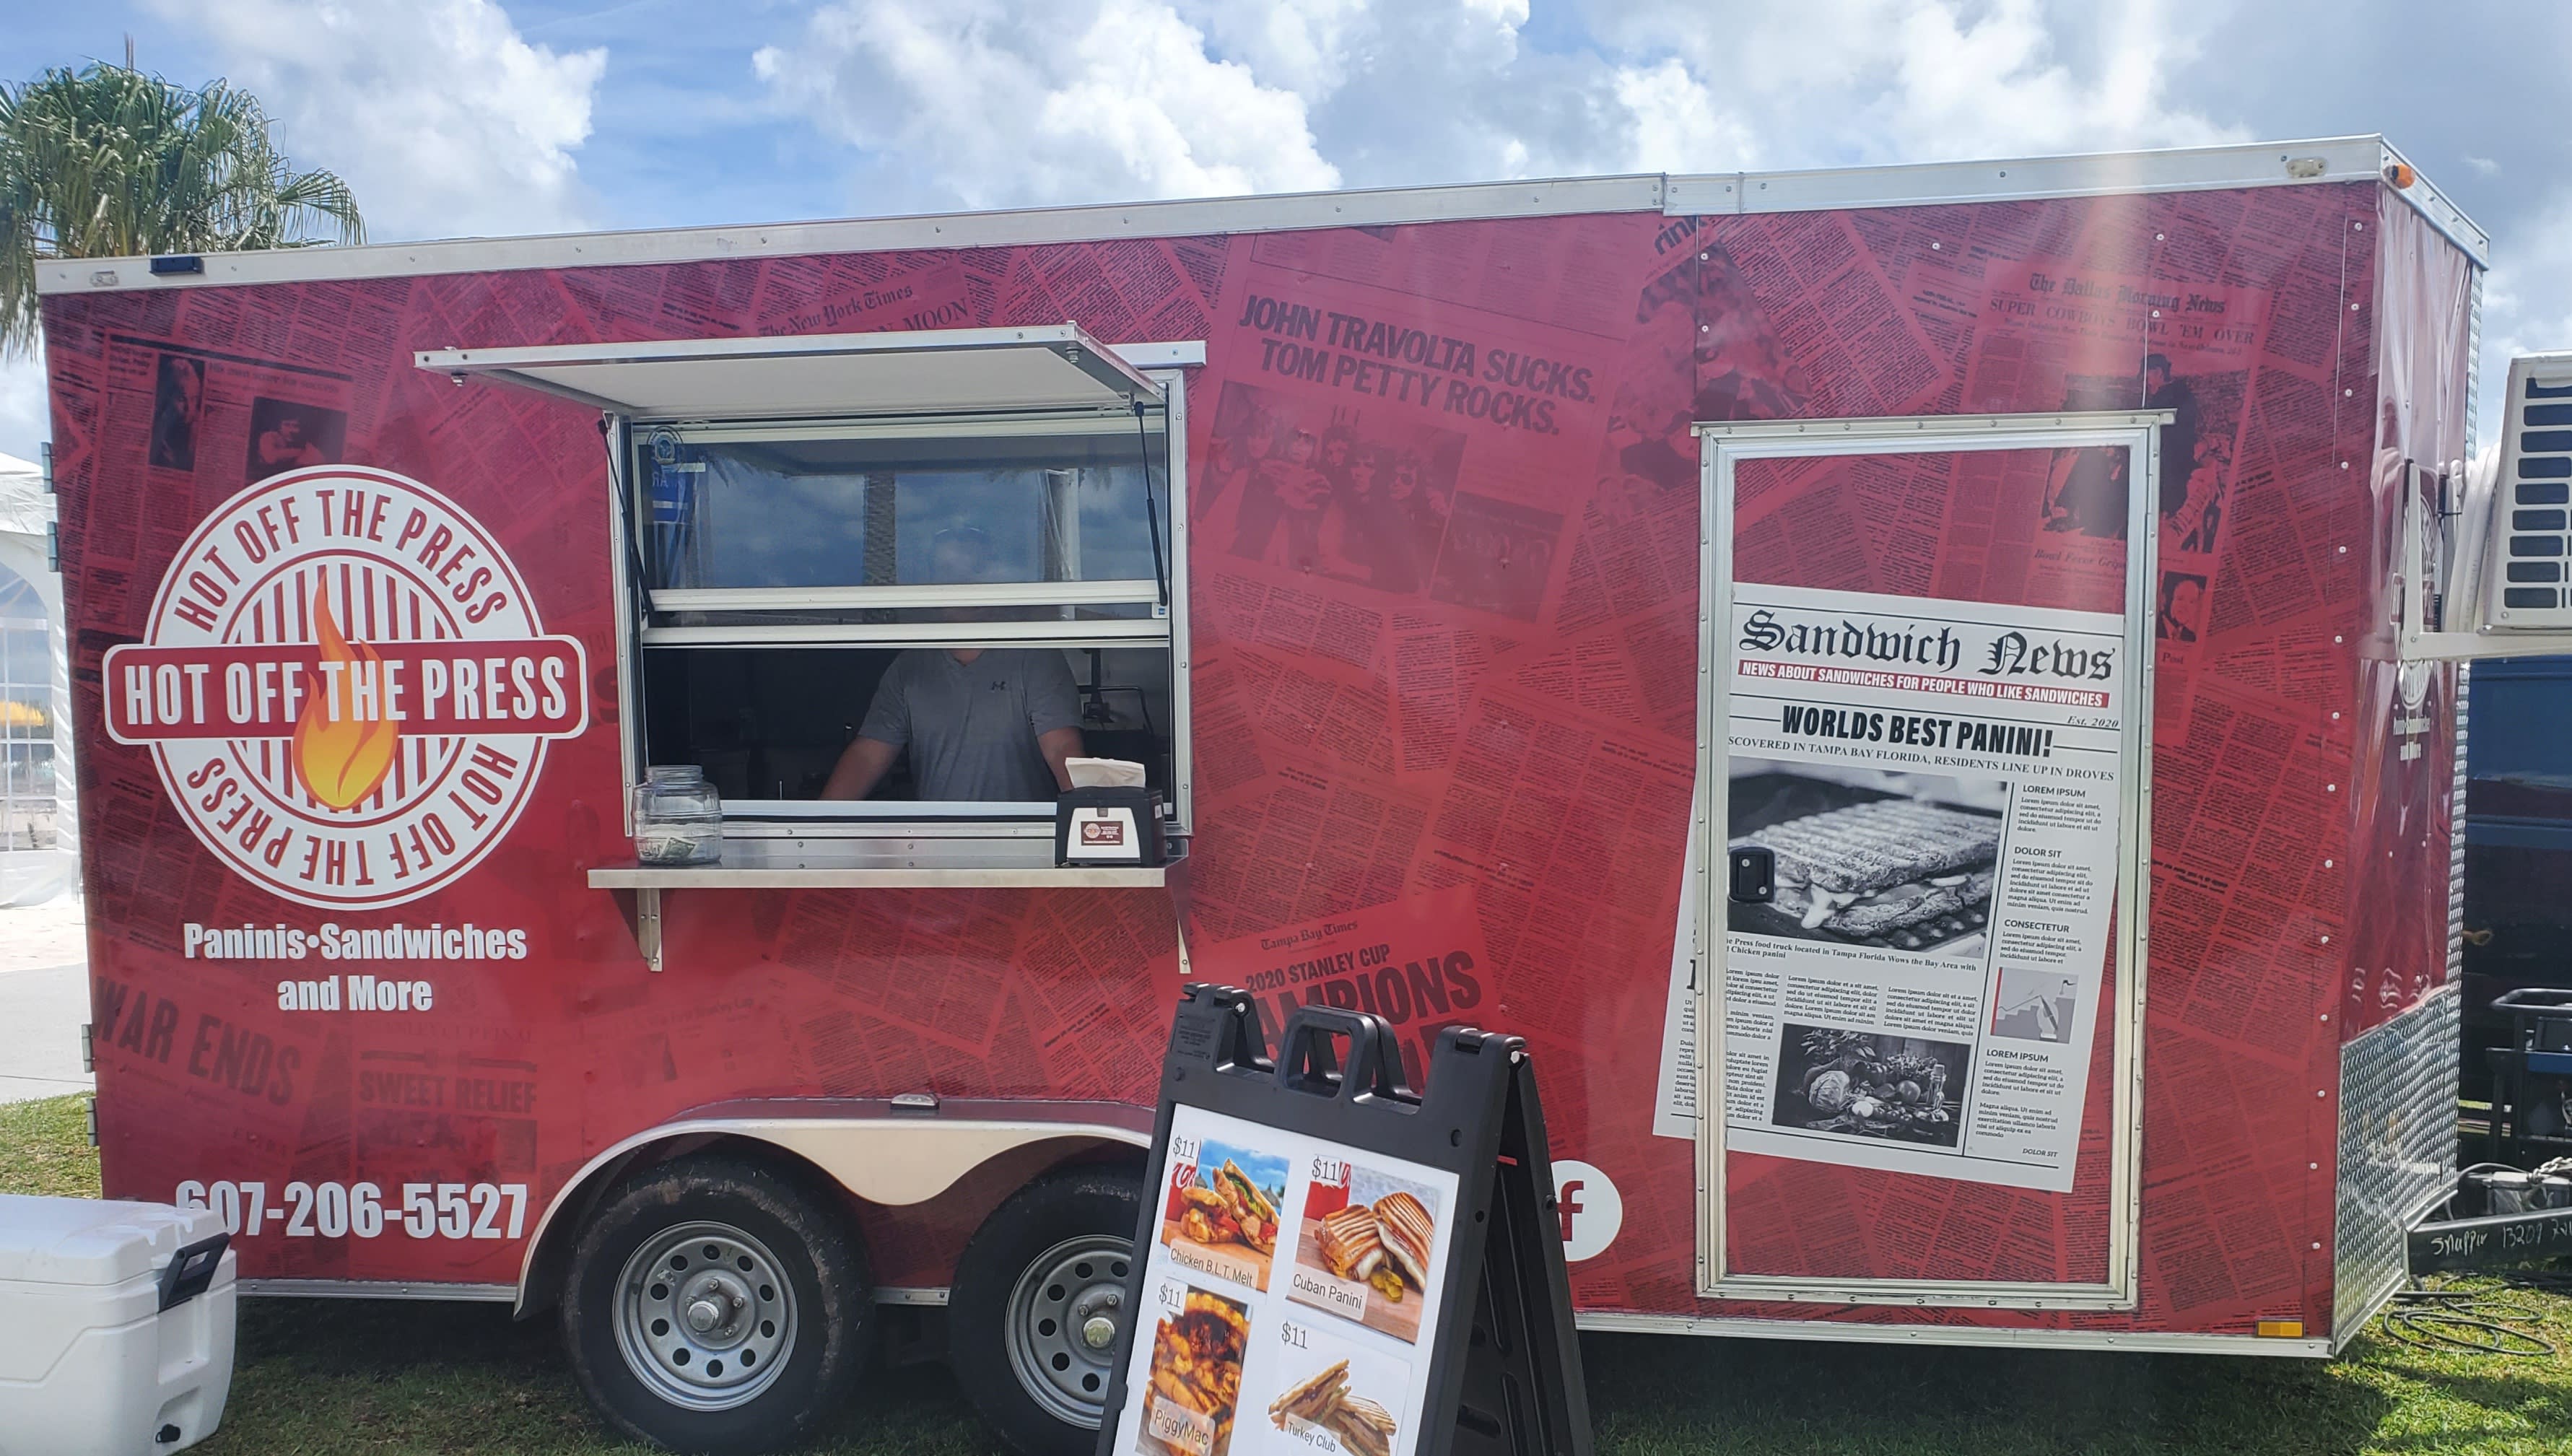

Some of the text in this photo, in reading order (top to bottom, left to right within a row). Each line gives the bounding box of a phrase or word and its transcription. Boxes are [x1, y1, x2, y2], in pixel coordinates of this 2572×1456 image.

[787, 313, 821, 334] New
[821, 297, 863, 328] York
[863, 284, 914, 310] Times
[902, 299, 969, 331] MOON
[2184, 292, 2226, 315] News
[1989, 298, 2036, 316] SUPER
[2046, 305, 2116, 328] COWBOYS
[2126, 316, 2170, 336] BOWL
[2213, 328, 2255, 346] OVER
[1239, 295, 1598, 404] JOHN TRAVOLTA SUCKS.
[1260, 338, 1560, 436] TOM PETTY ROCKS.
[174, 489, 507, 633] HOT OFF THE PRESS
[1739, 609, 2116, 680] Sandwich News
[125, 656, 567, 725] HOT OFF THE PRESS
[1743, 662, 2103, 707] NEWS ABOUT SANDWICHES FOR PEOPLE WHO LIKE SANDWICHES
[1782, 705, 2053, 758] WORLDS BEST PANINI!
[2067, 715, 2119, 728] Est. 2020
[1793, 742, 1807, 753] IN
[1808, 744, 1848, 757] TAMPA
[1850, 748, 1875, 759] BAY
[1877, 749, 1931, 766] FLORIDA,
[1935, 755, 1999, 772] RESIDENTS
[2002, 762, 2030, 773] LINE
[2033, 764, 2048, 776] UP
[2050, 766, 2064, 777] IN
[2066, 767, 2114, 782] DROVES
[2023, 785, 2085, 798] LOREM IPSUM
[188, 743, 518, 886] HOT OFF THE PRESS
[2054, 808, 2084, 816] adipiscing
[2014, 846, 2062, 858] DOLOR SIT
[2032, 860, 2050, 868] ipsum
[1260, 936, 1299, 951] Tampa
[1300, 928, 1324, 943] Bay
[1324, 920, 1358, 938] Times
[2004, 919, 2070, 933] CONSECTETUR
[1245, 971, 1286, 993] 2020
[1288, 951, 1354, 984] STANLEY
[1359, 943, 1391, 967] CUP
[1731, 945, 1761, 956] Chicken
[1762, 949, 1787, 959] panini
[1735, 938, 1754, 947] Press
[1755, 940, 1771, 949] food
[1773, 943, 1793, 951] truck
[1795, 945, 1821, 955] located
[1831, 949, 1857, 959] Tampa
[1859, 952, 1886, 962] Florida
[1888, 955, 1910, 965] Wows
[1924, 959, 1940, 969] Bay
[1940, 962, 1958, 970] Area
[278, 975, 434, 1011] and More
[92, 976, 301, 1106] WAR ENDS
[1987, 1049, 2049, 1063] LOREM IPSUM
[359, 1071, 537, 1113] SWEET RELIEF
[1173, 1135, 1195, 1159] $11
[2022, 1148, 2046, 1156] DOLOR
[1312, 1156, 1338, 1182] $11
[1170, 1247, 1252, 1287] Chicken B.L.T. Melt
[1159, 1282, 1181, 1308] $11
[1293, 1273, 1363, 1309] Cuban Panini
[1281, 1320, 1307, 1349] $11
[1154, 1408, 1209, 1446] PiggyMac
[1288, 1421, 1336, 1452] Turkey Club
